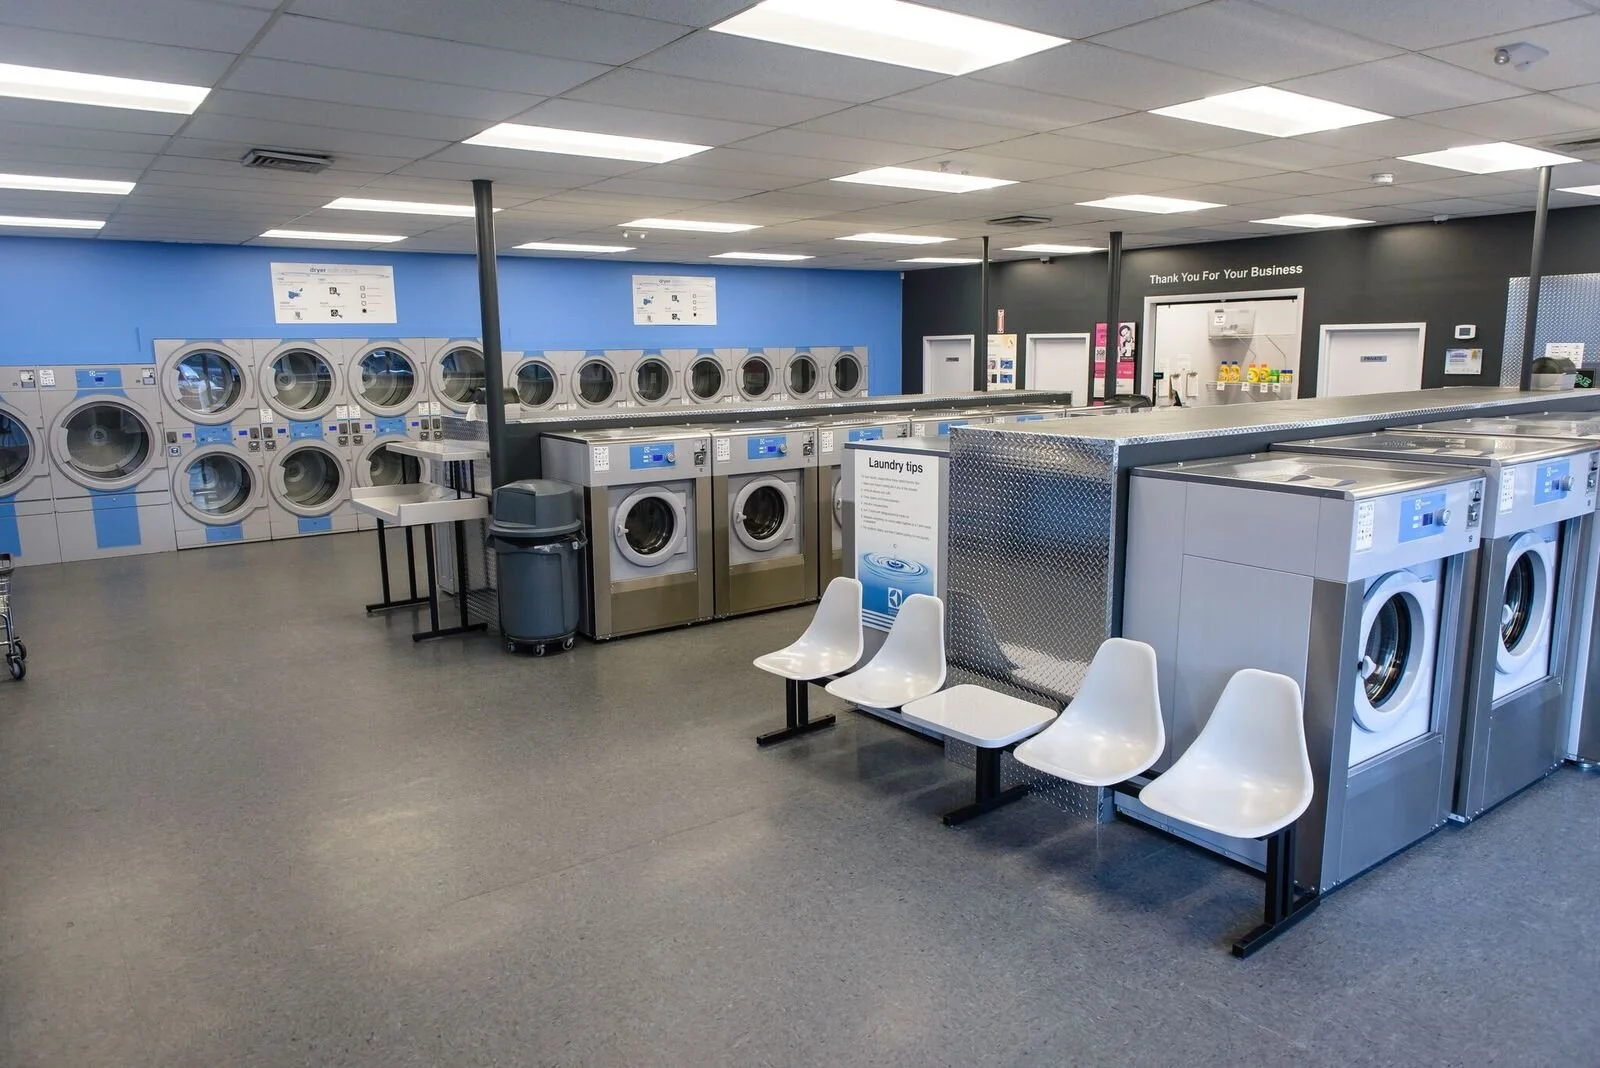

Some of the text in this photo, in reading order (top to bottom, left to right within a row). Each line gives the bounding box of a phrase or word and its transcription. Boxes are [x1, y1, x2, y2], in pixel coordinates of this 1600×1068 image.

[309, 266, 327, 274] dryer
[1149, 264, 1304, 285] Thank You For Your Business
[868, 457, 924, 475] Laundry tips
